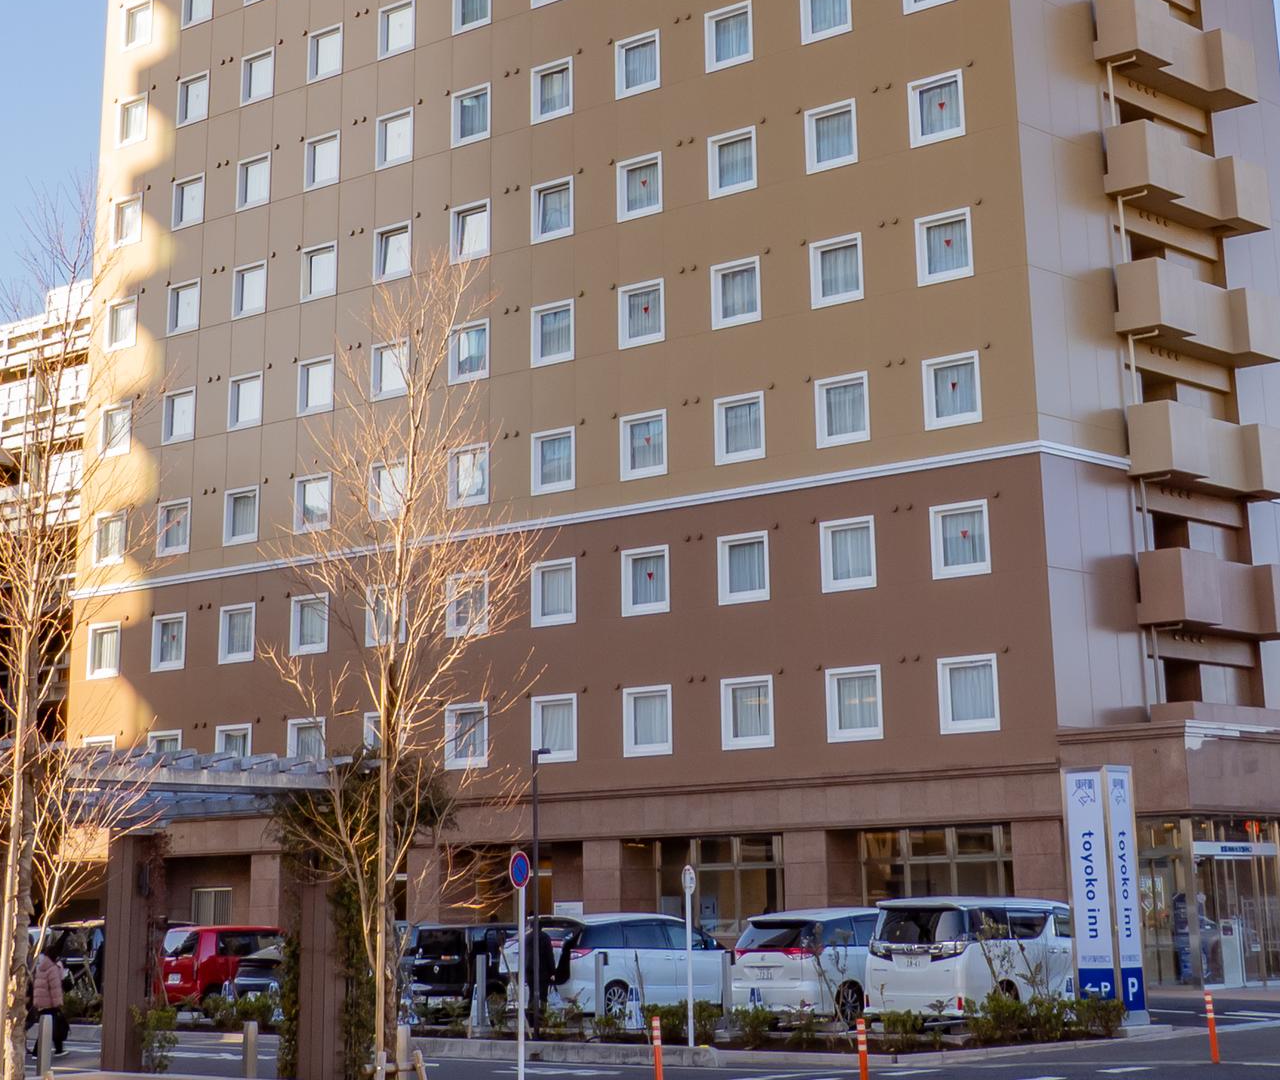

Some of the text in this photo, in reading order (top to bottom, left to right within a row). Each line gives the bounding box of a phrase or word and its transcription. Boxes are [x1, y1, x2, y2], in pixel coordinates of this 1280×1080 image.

[1081, 830, 1098, 901] toyoko
[1118, 830, 1132, 938] toyoko inn
[1087, 908, 1100, 939] inn
[1100, 981, 1111, 997] P
[1128, 977, 1139, 1001] P
